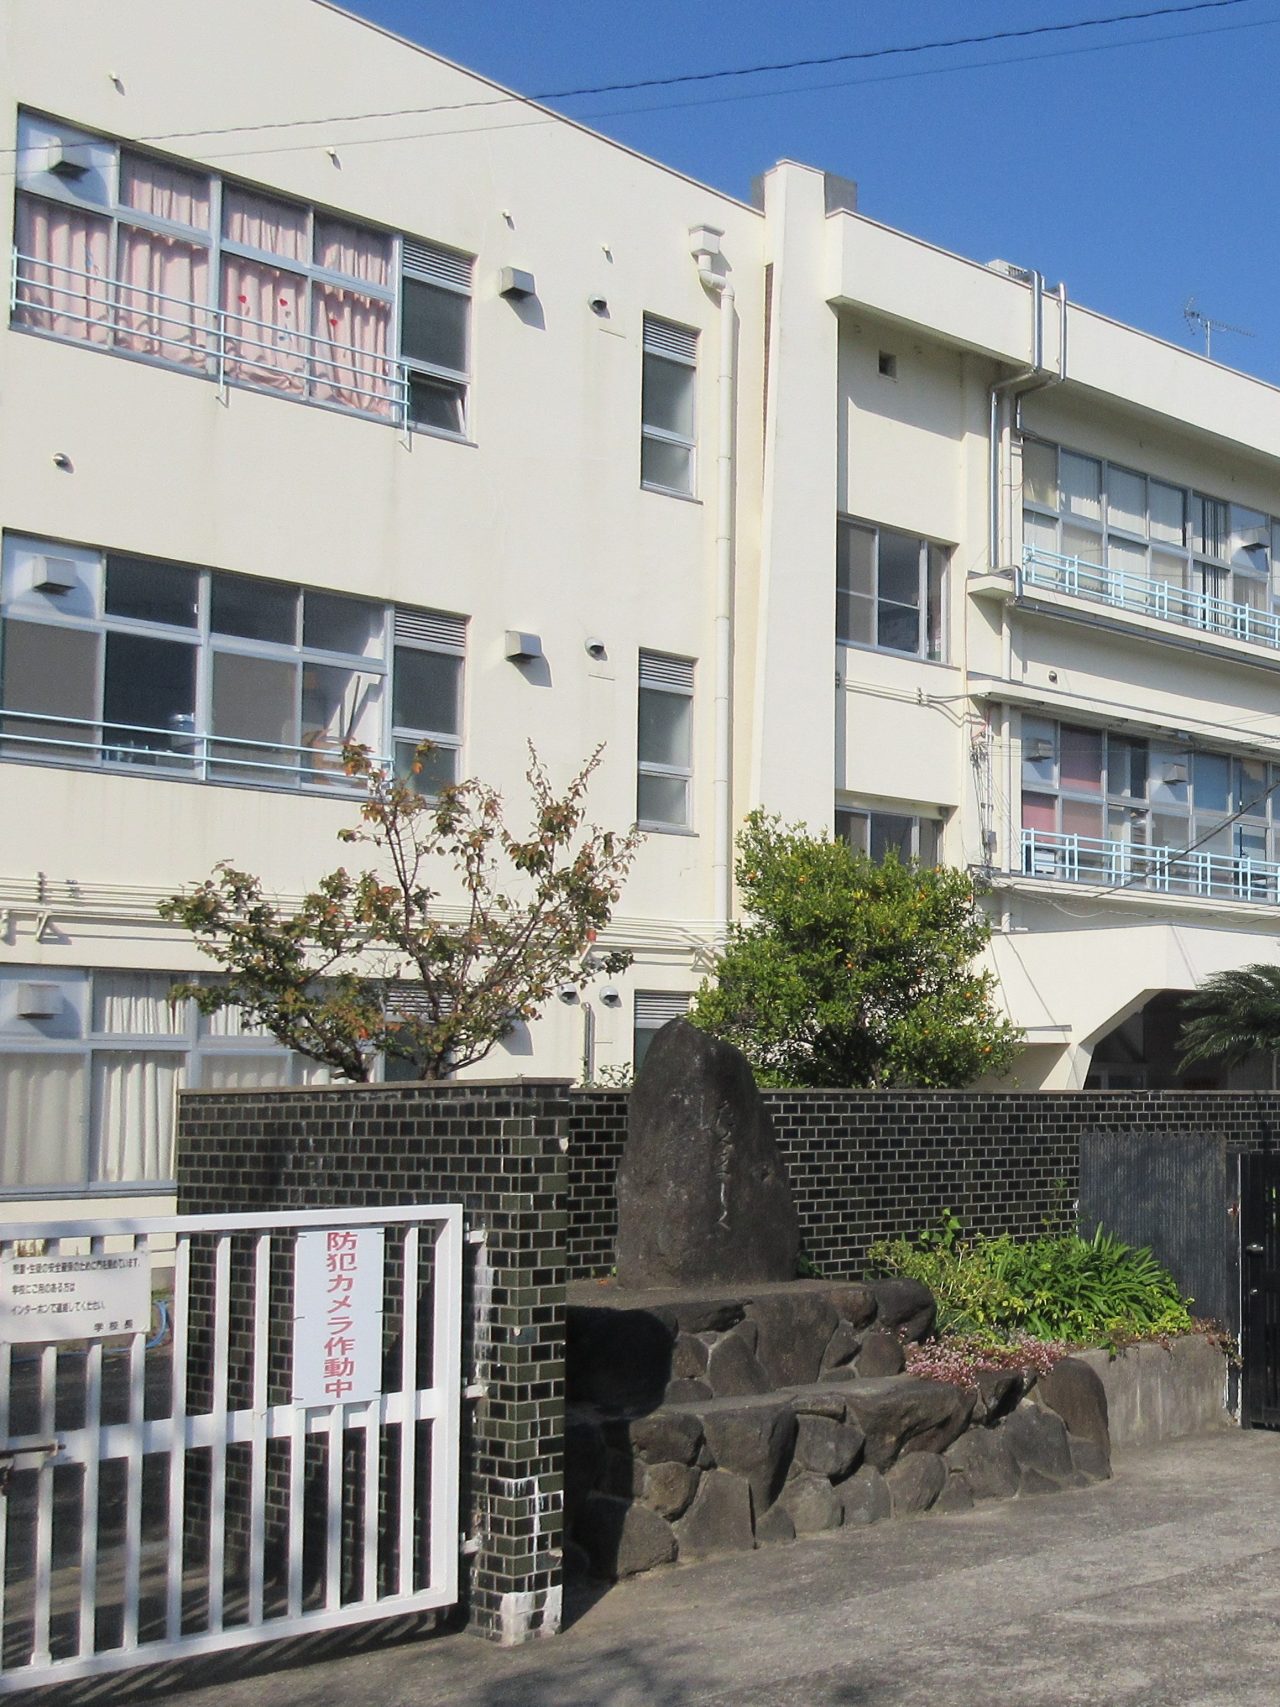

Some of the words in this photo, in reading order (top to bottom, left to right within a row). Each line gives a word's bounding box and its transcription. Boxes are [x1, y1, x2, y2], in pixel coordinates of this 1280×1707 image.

[94, 1319, 134, 1332] 学校長
[324, 1231, 358, 1399] 防犯カメラ作動中
